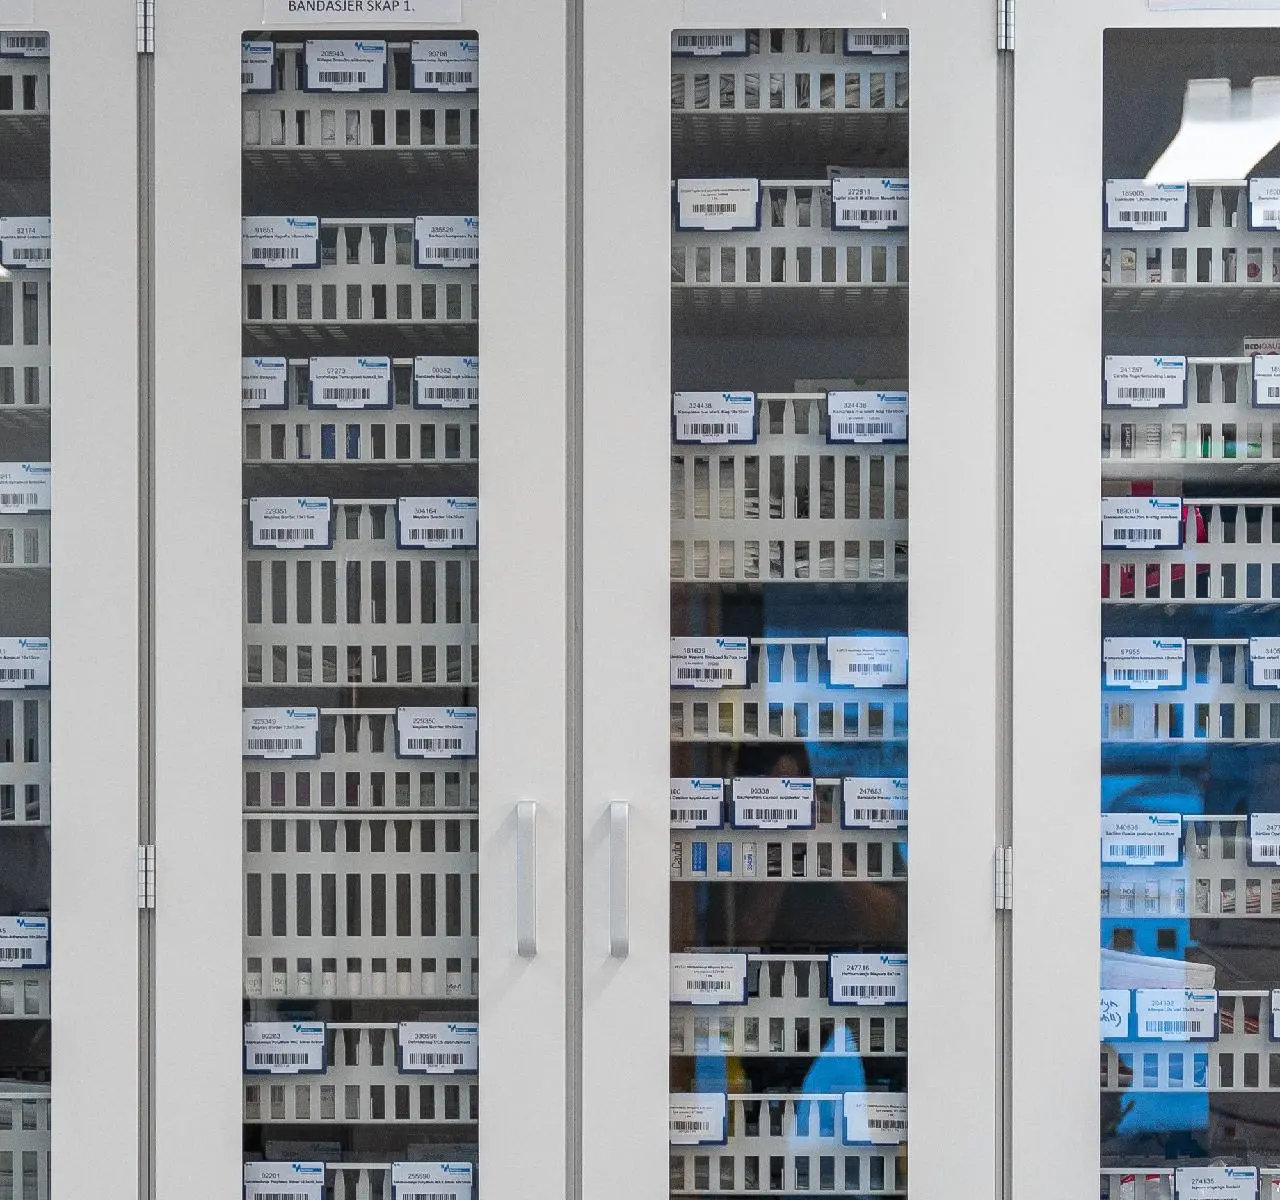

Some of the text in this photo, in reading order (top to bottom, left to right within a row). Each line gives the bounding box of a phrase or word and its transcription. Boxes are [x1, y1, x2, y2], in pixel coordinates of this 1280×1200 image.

[288, 0, 415, 11] BANDASJER SKAP 1.
